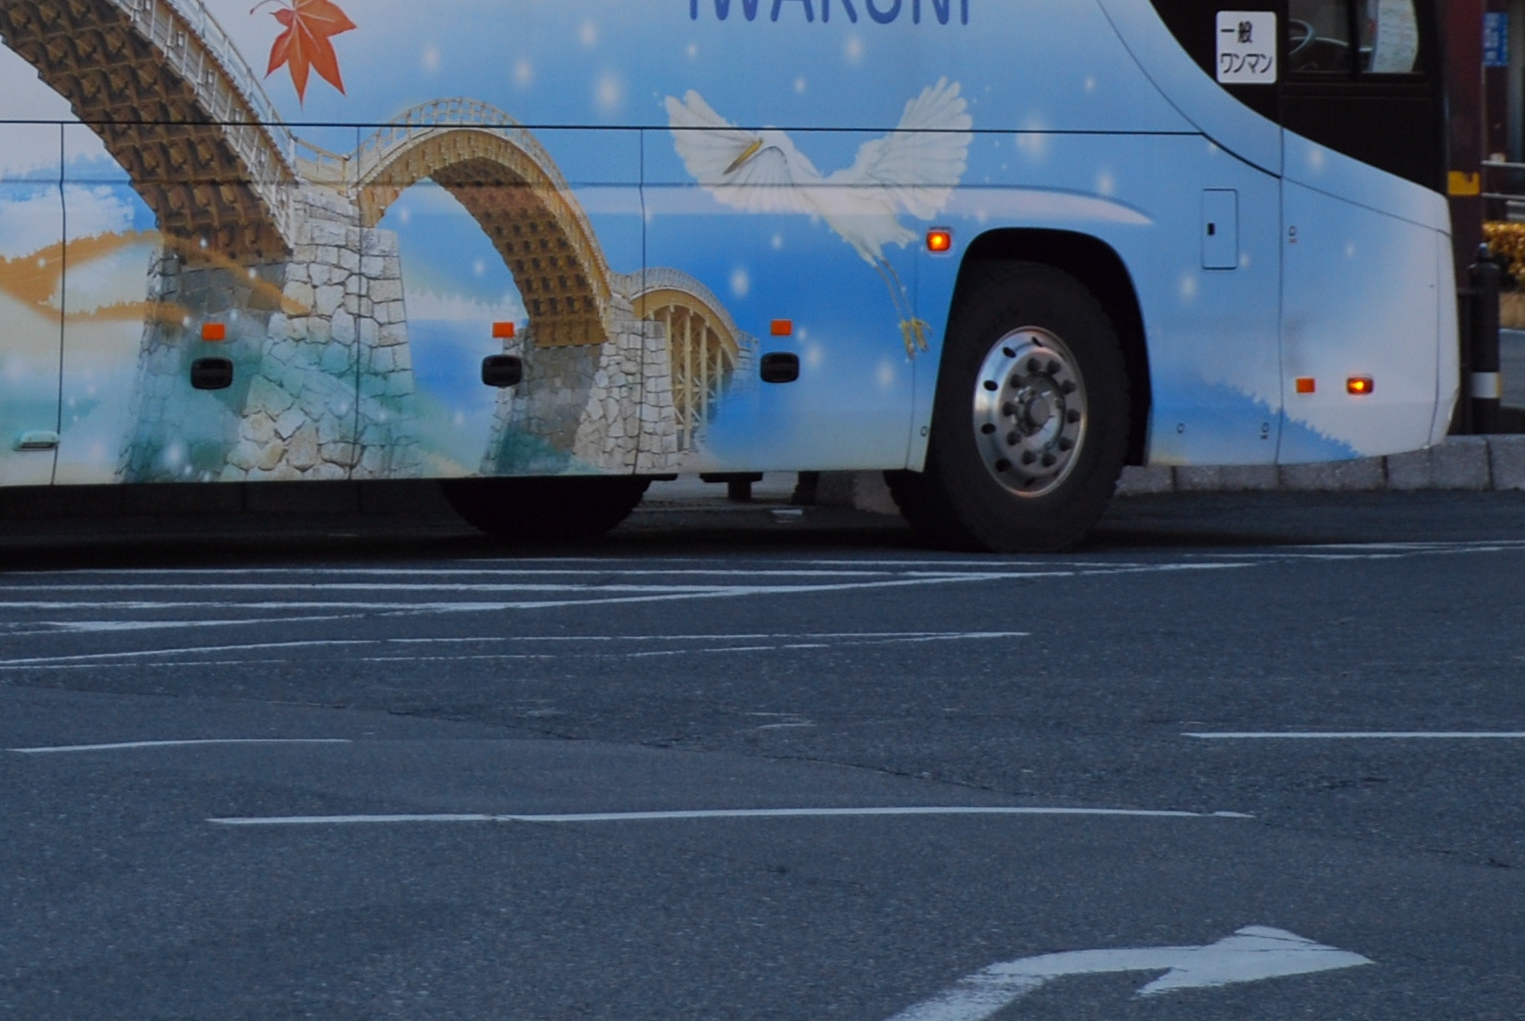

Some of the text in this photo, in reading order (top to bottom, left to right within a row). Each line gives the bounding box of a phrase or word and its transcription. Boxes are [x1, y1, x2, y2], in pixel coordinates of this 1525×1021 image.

[1219, 20, 1253, 43] 一般
[1220, 53, 1273, 74] ワンマン
